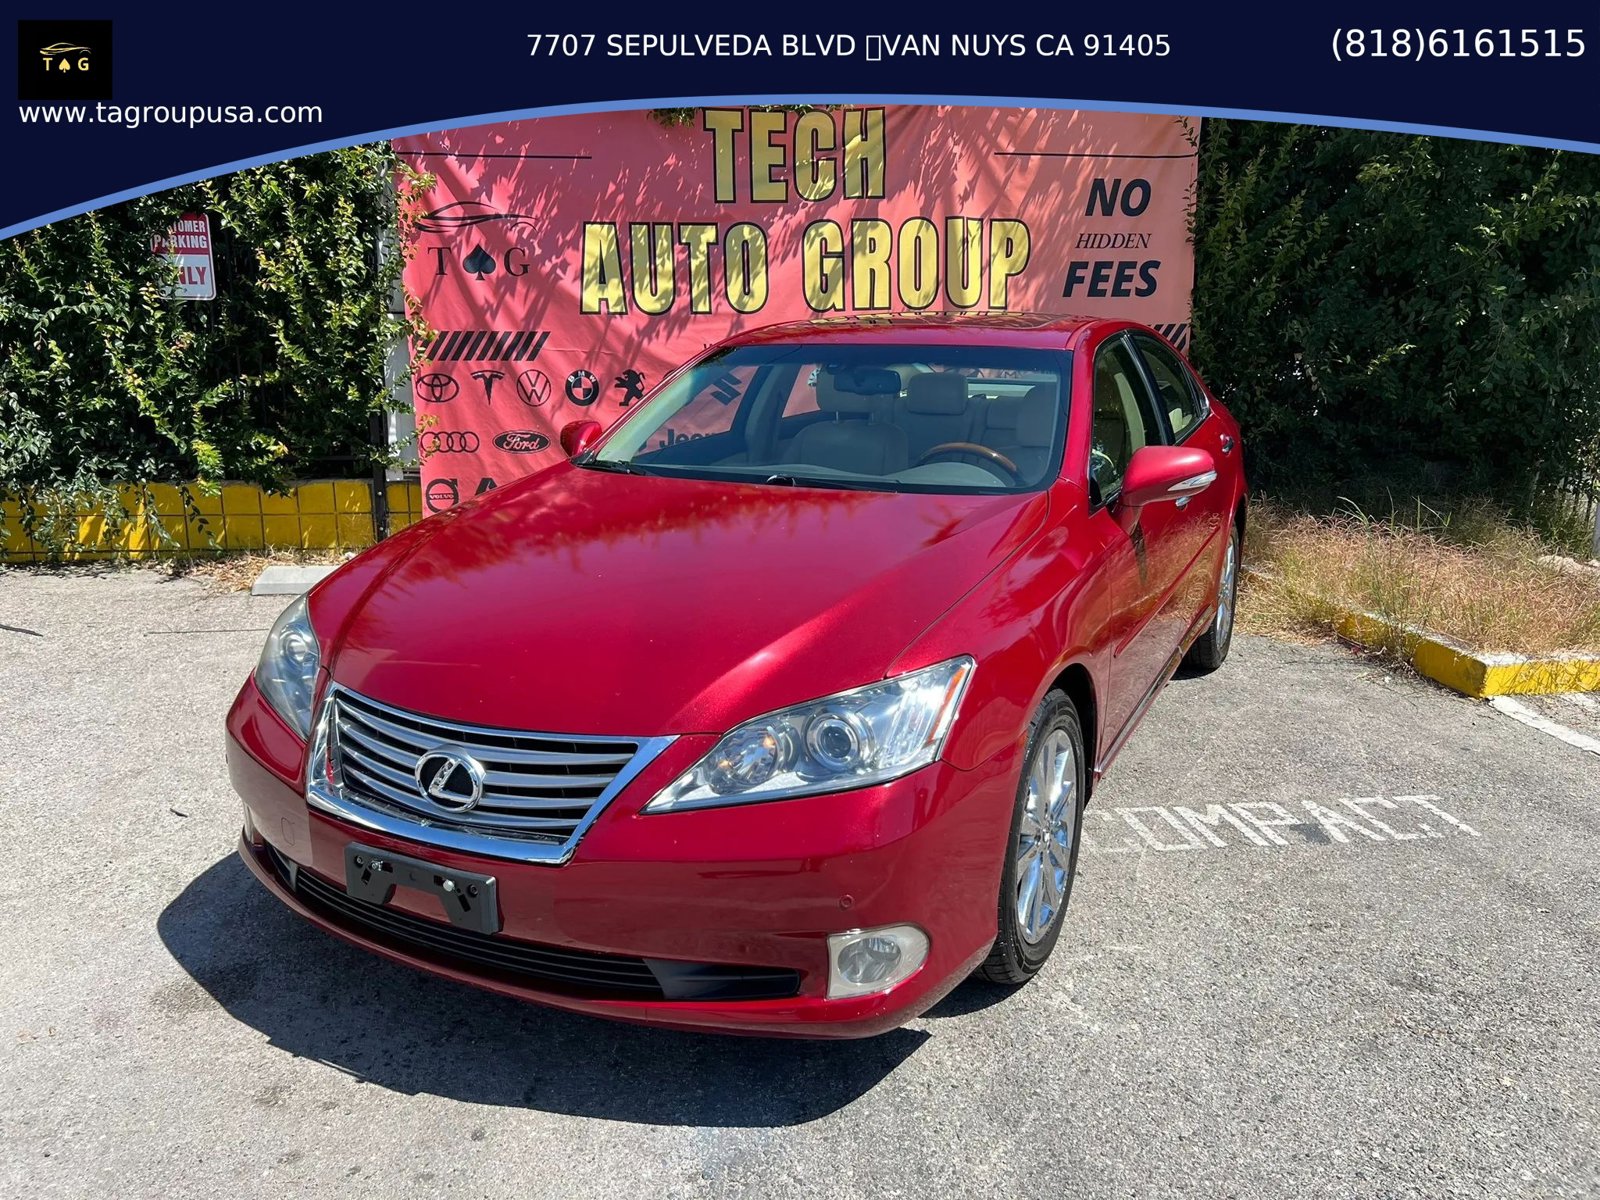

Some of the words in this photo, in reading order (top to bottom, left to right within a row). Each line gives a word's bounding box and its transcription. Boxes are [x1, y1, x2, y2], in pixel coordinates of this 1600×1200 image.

[704, 107, 887, 204] TECH
[1085, 178, 1152, 217] NO
[153, 235, 208, 249] PARKING
[1075, 232, 1152, 250] HIDDEN
[580, 221, 769, 316] AUTO
[802, 216, 1031, 312] GROUP
[1062, 260, 1162, 298] FEES
[567, 370, 597, 383] BMW
[503, 432, 540, 450] Ford
[1083, 794, 1481, 851] COMPACT
